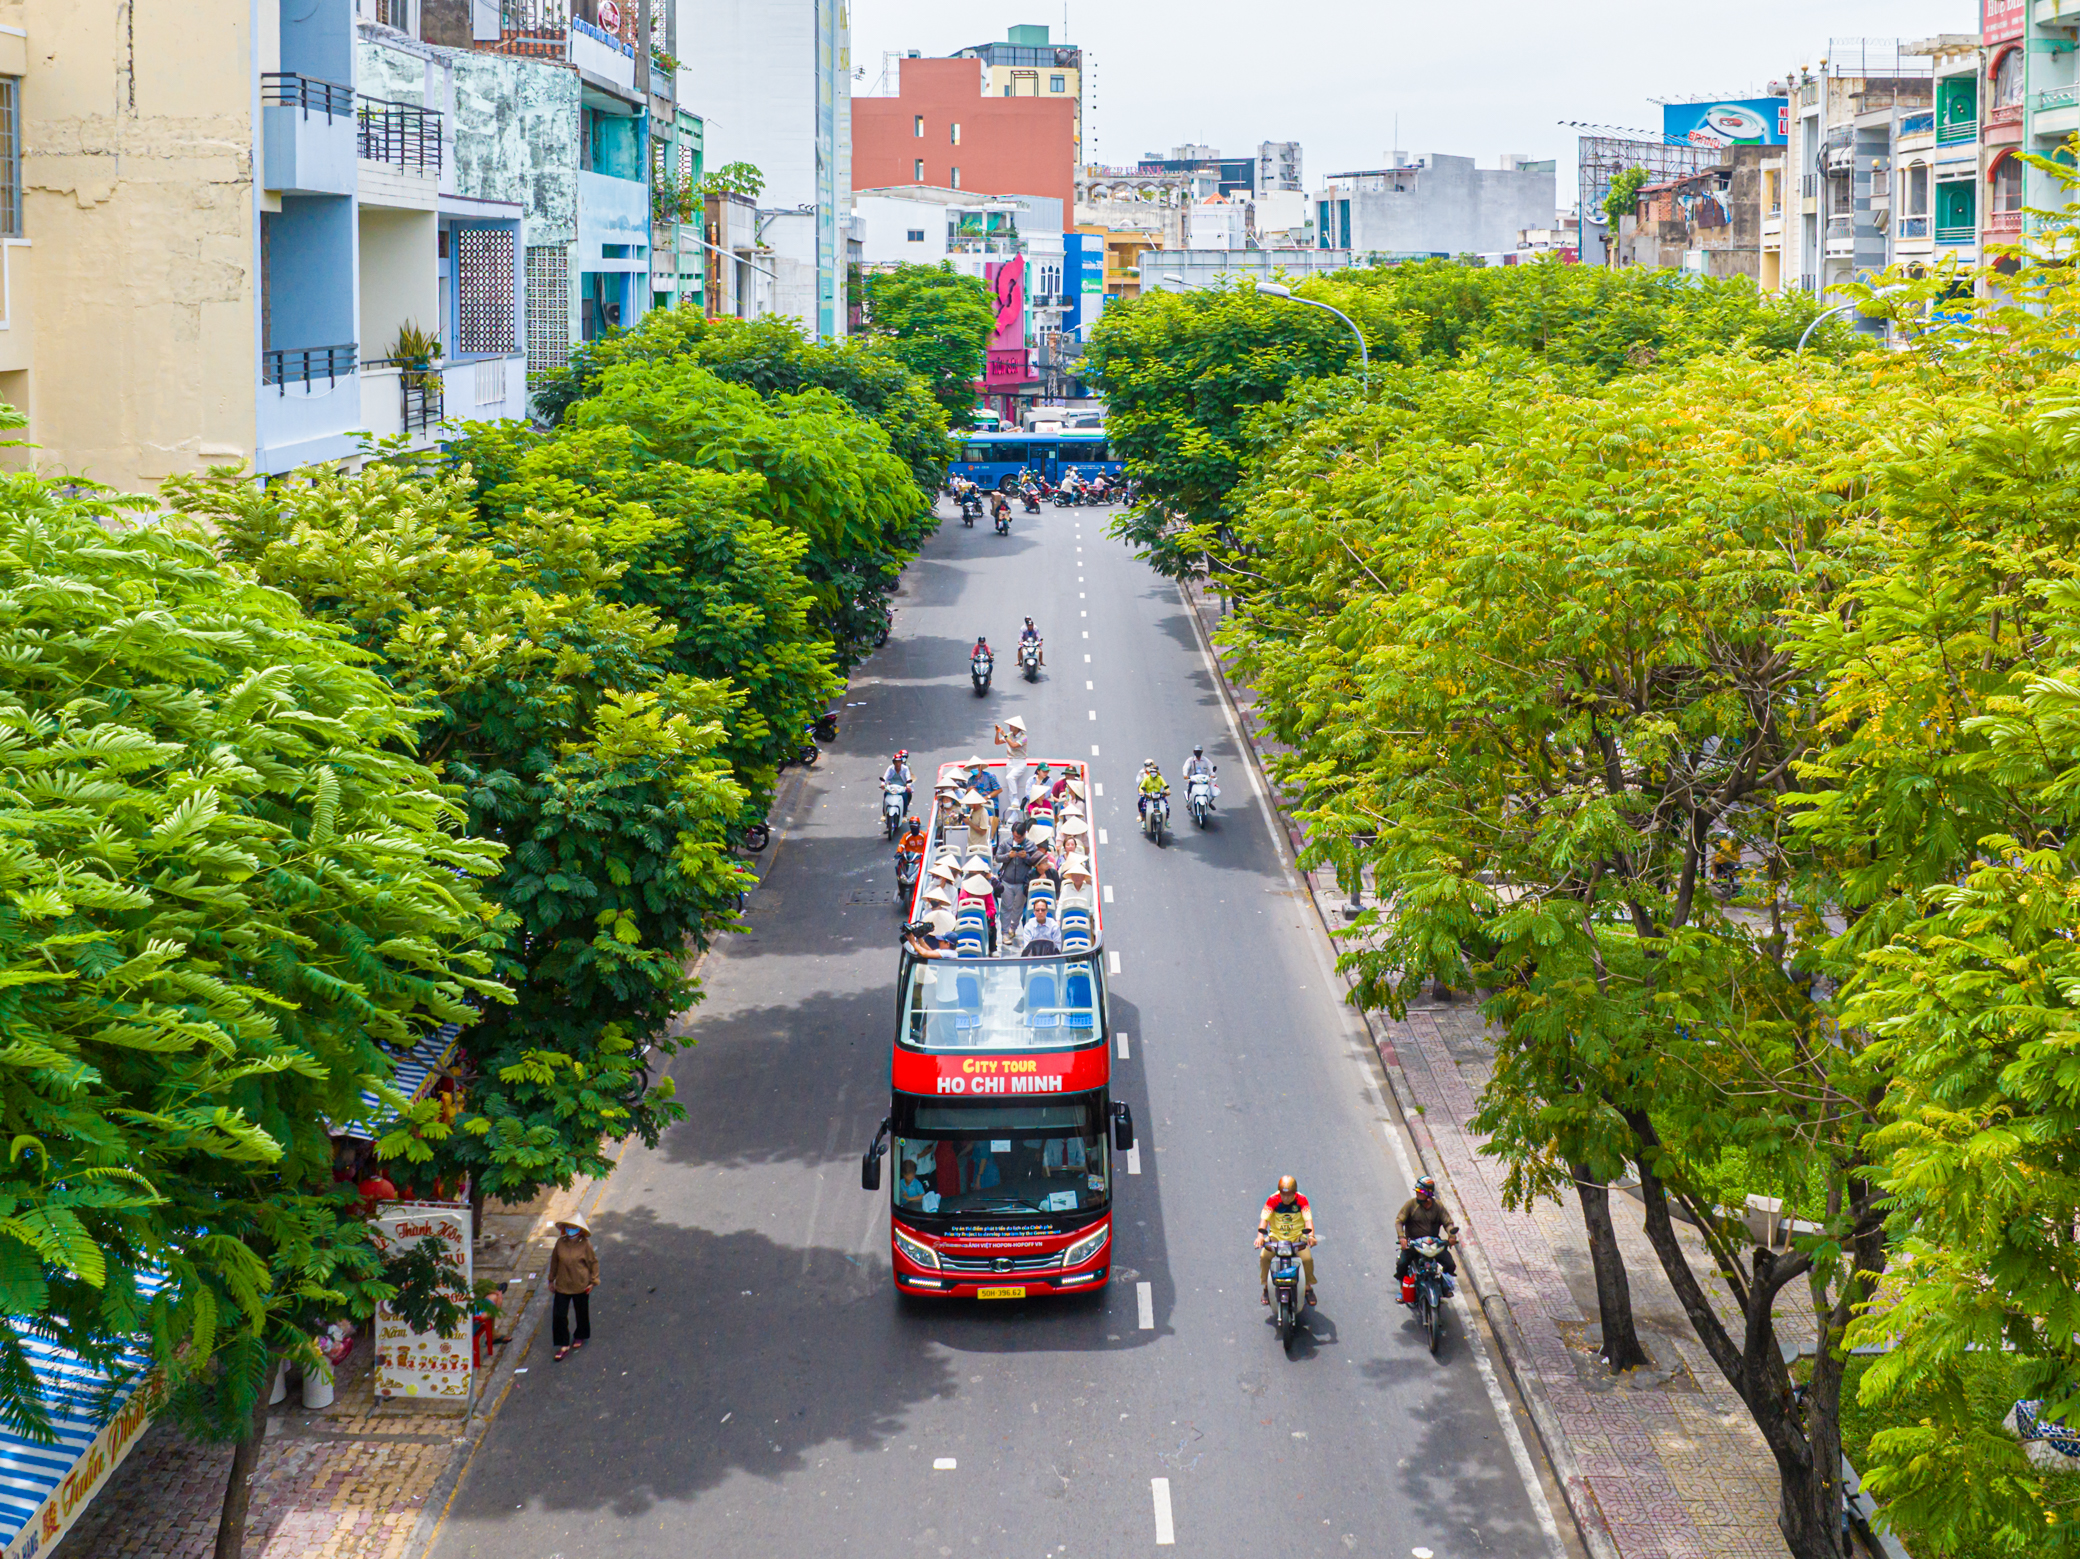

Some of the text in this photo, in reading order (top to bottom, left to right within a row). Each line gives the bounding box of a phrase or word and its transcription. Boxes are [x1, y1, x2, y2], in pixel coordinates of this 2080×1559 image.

[1002, 1060, 1036, 1073] TOUR
[937, 1076, 1062, 1093] HO CHI MINH
[396, 1220, 432, 1239] Thành
